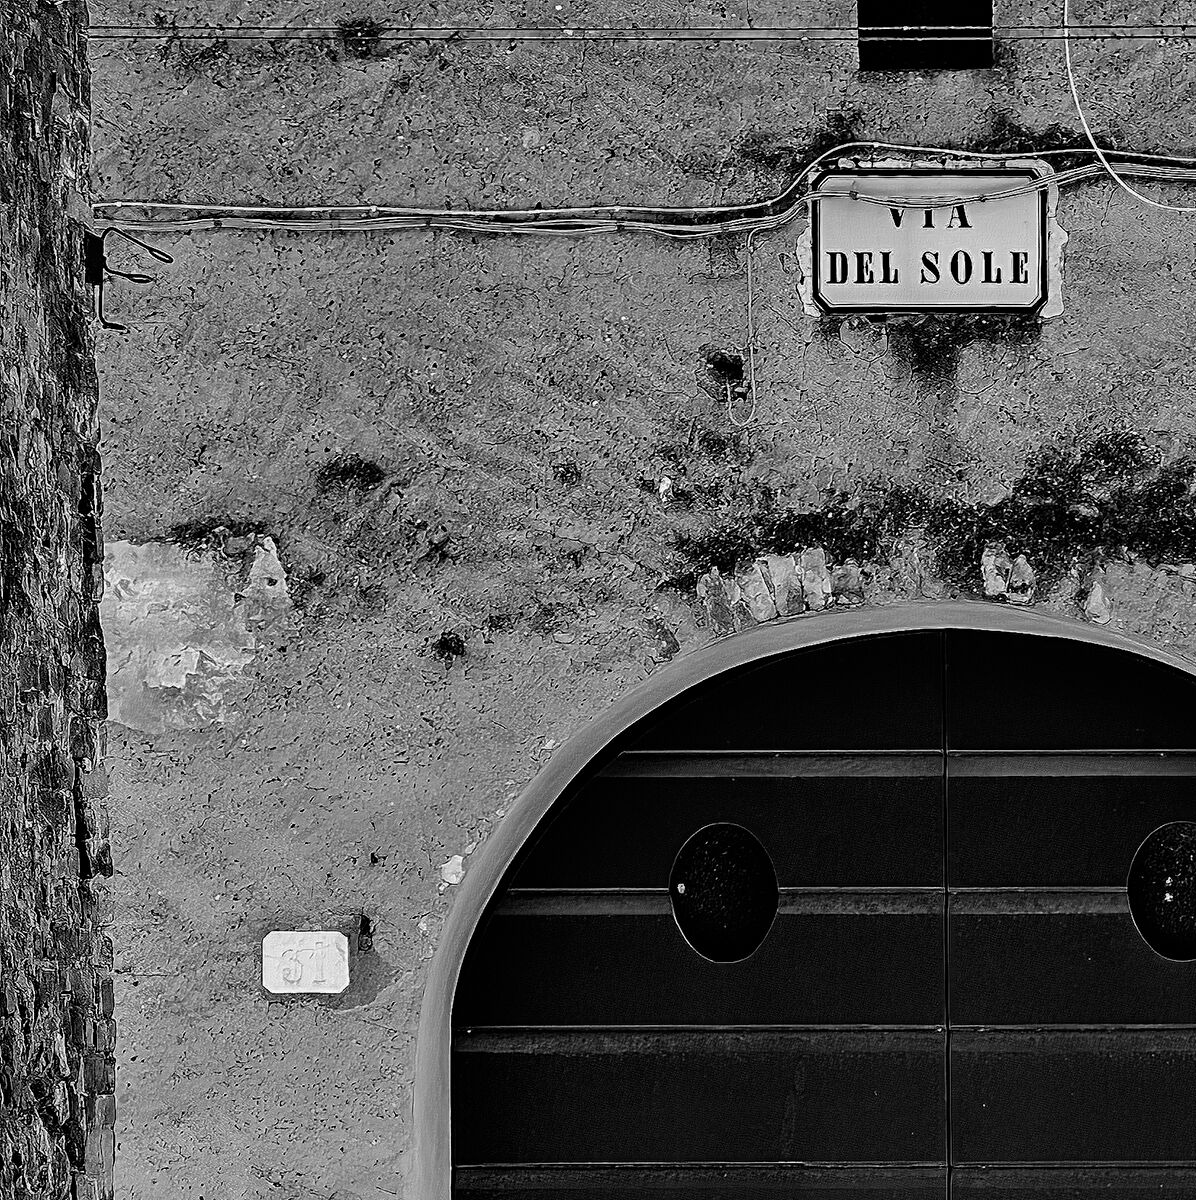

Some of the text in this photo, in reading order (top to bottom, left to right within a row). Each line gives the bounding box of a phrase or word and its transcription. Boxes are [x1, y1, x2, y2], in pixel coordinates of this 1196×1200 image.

[889, 204, 973, 229] VIA
[826, 250, 1029, 285] DEL SOLE
